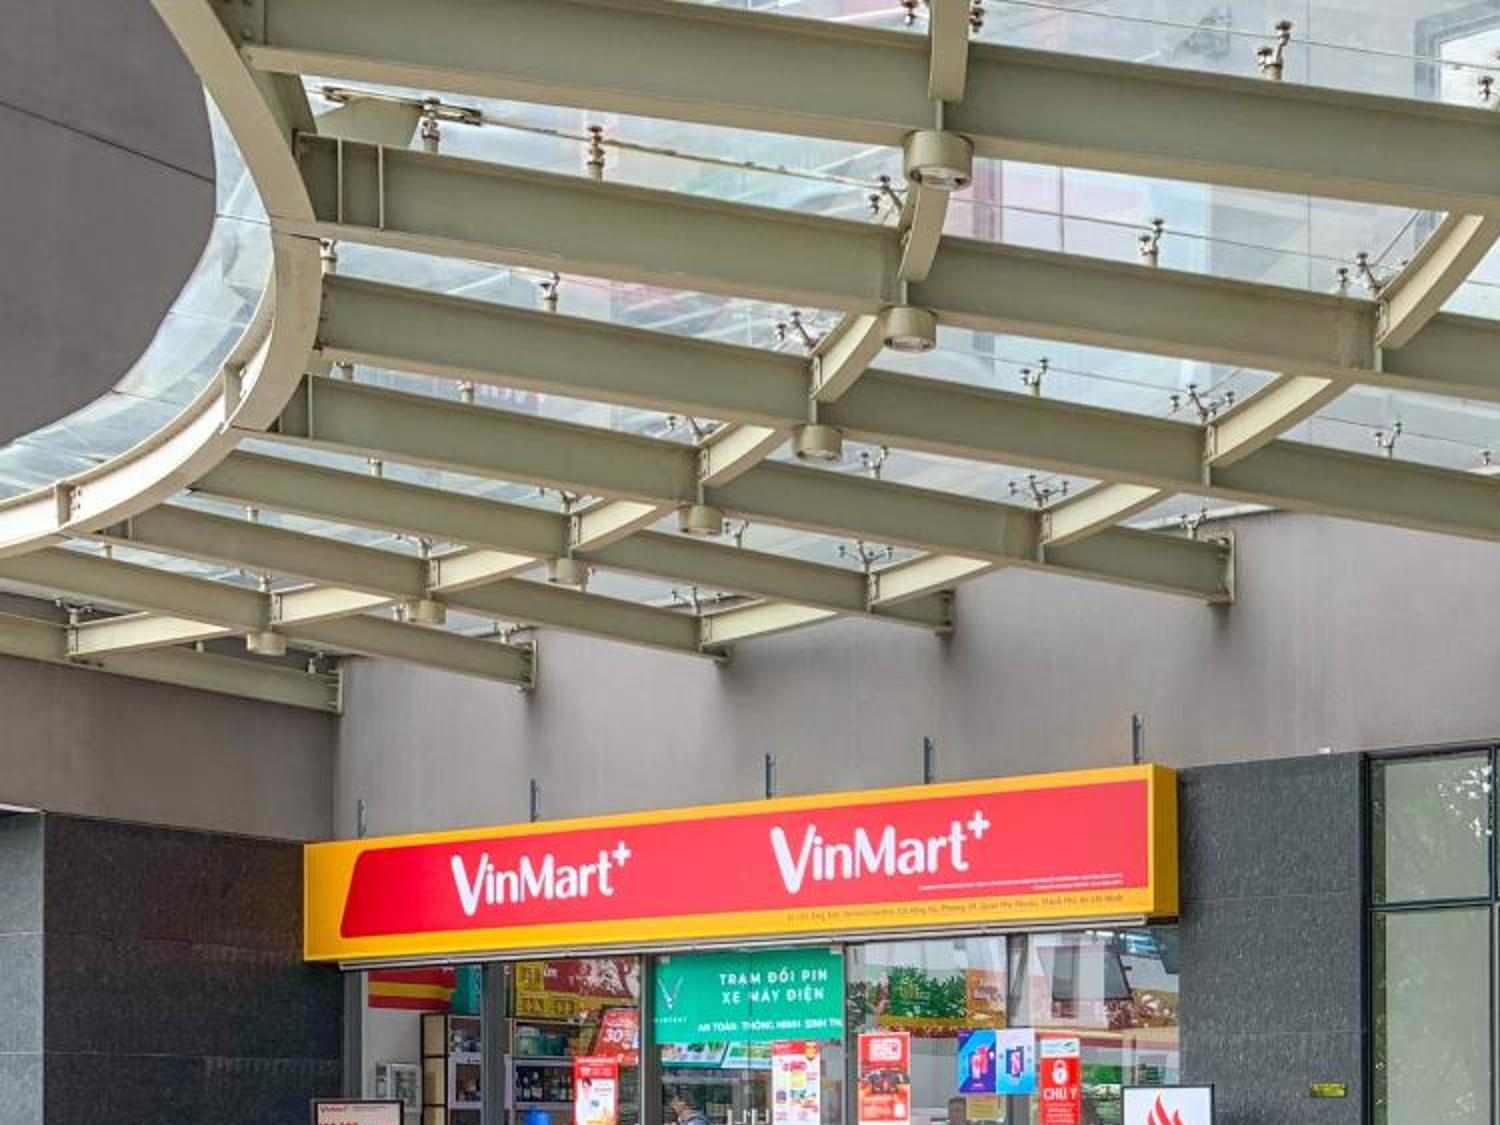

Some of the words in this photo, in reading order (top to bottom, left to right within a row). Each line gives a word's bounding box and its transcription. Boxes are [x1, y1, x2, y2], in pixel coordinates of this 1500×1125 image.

[770, 810, 991, 895] VinMart+
[450, 841, 632, 917] VinMart+
[721, 991, 742, 1005] XE
[801, 969, 828, 982] PIN
